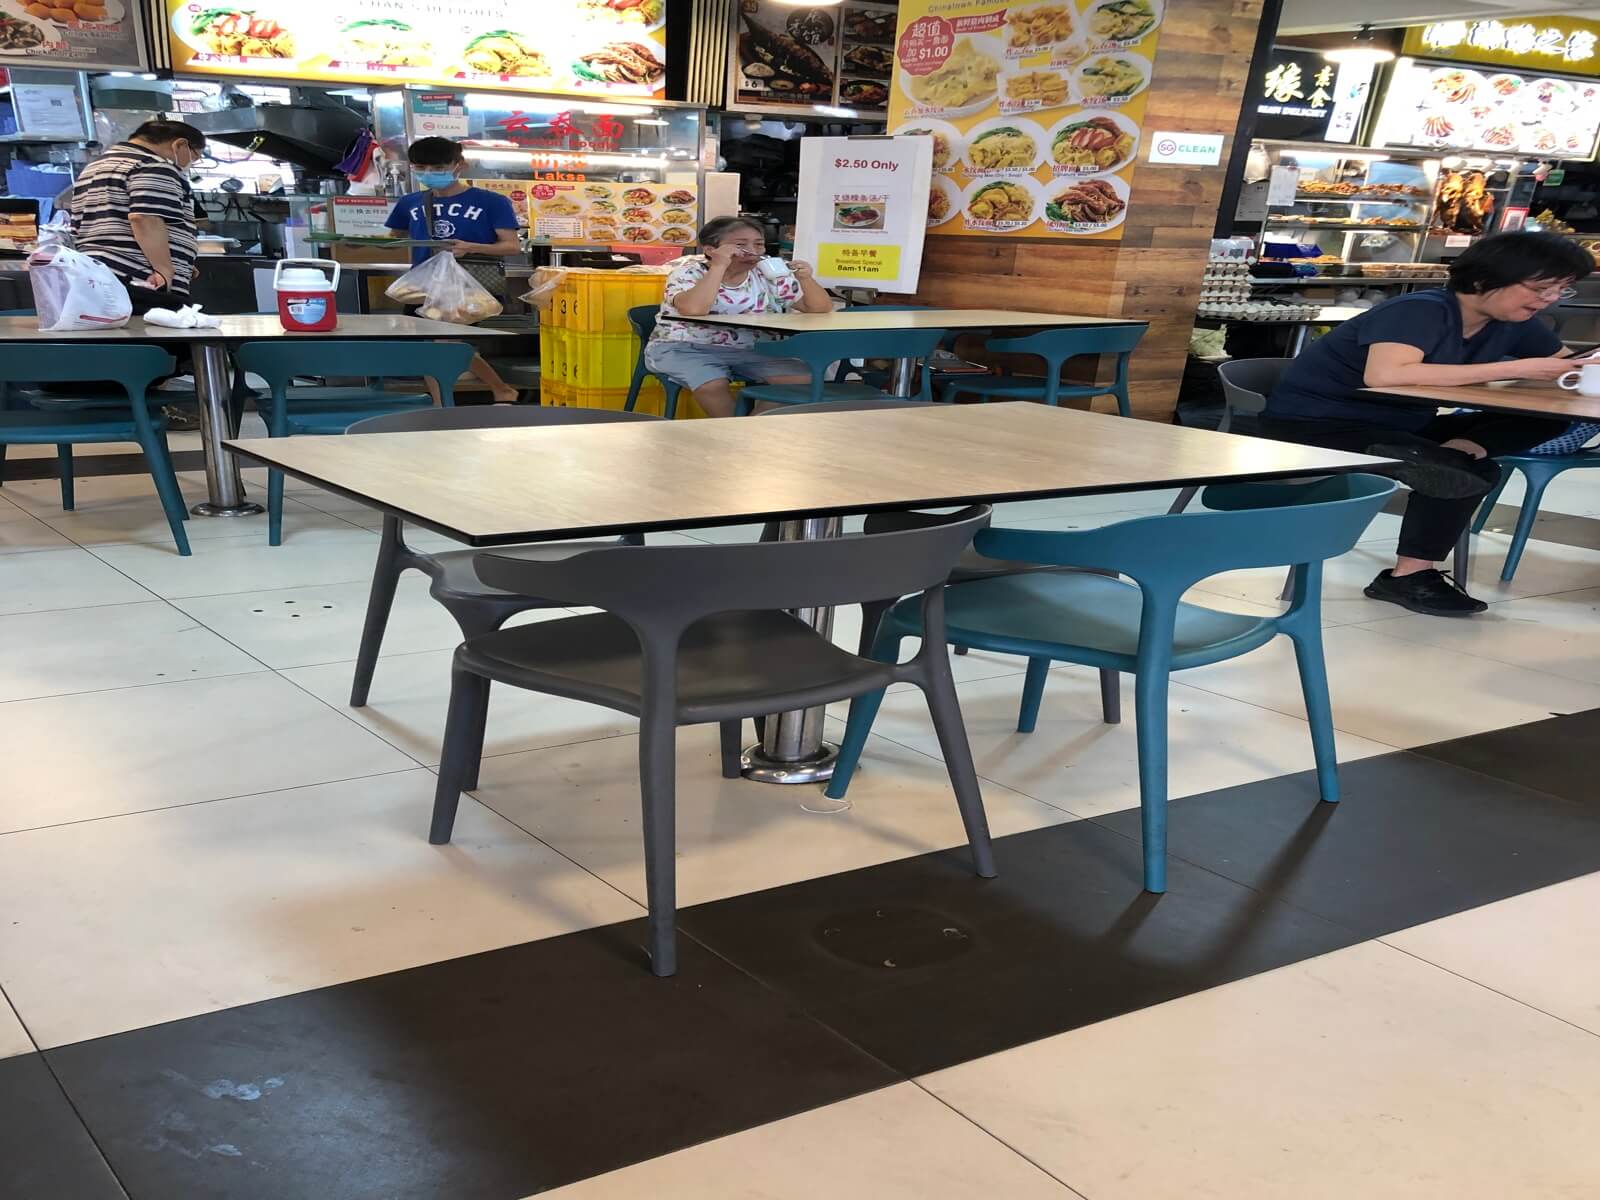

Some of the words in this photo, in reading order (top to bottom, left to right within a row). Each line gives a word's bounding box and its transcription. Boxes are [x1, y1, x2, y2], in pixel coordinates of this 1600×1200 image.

[911, 20, 941, 39] 超值
[919, 46, 949, 60] $1.00
[1178, 144, 1216, 154] CLEAN
[835, 158, 868, 169] $2.50
[871, 160, 899, 172] Only
[534, 171, 586, 183] Laksa
[837, 264, 880, 273] 8am-11am
